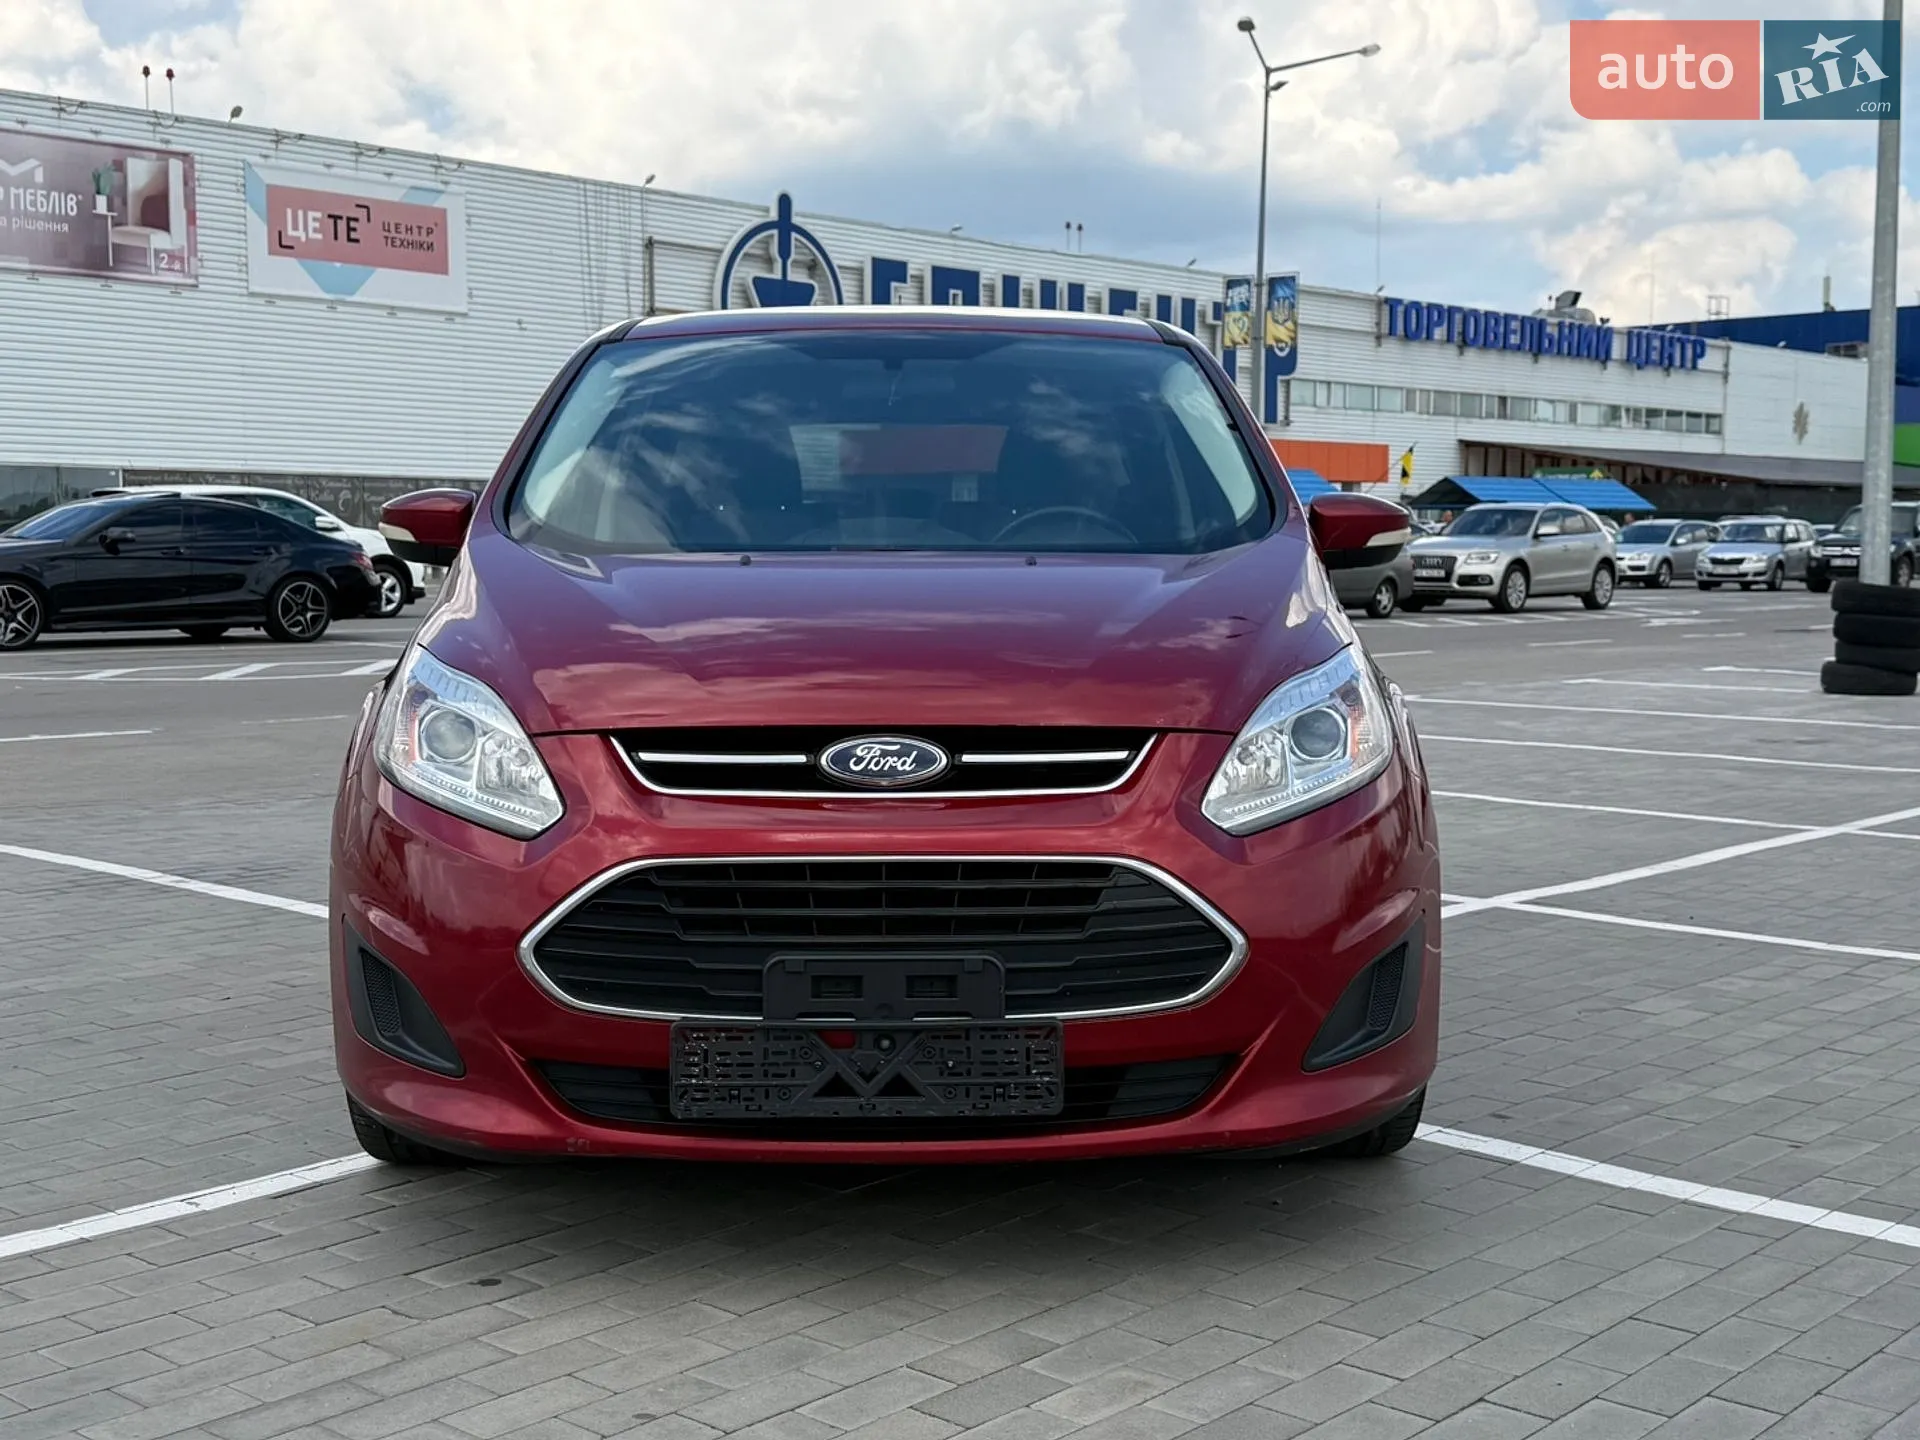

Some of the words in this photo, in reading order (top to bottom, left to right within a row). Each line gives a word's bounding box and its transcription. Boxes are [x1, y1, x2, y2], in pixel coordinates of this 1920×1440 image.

[10, 187, 77, 216] МЕБЛІВ
[12, 216, 69, 232] рішення
[382, 221, 434, 237] ЦЕНТР
[383, 236, 434, 252] ТЕХНІКИ
[1384, 297, 1614, 361] ТОРГОВЕЛЬНИЙ
[1626, 329, 1707, 370] ЦЕНТР
[850, 744, 918, 771] Ford
